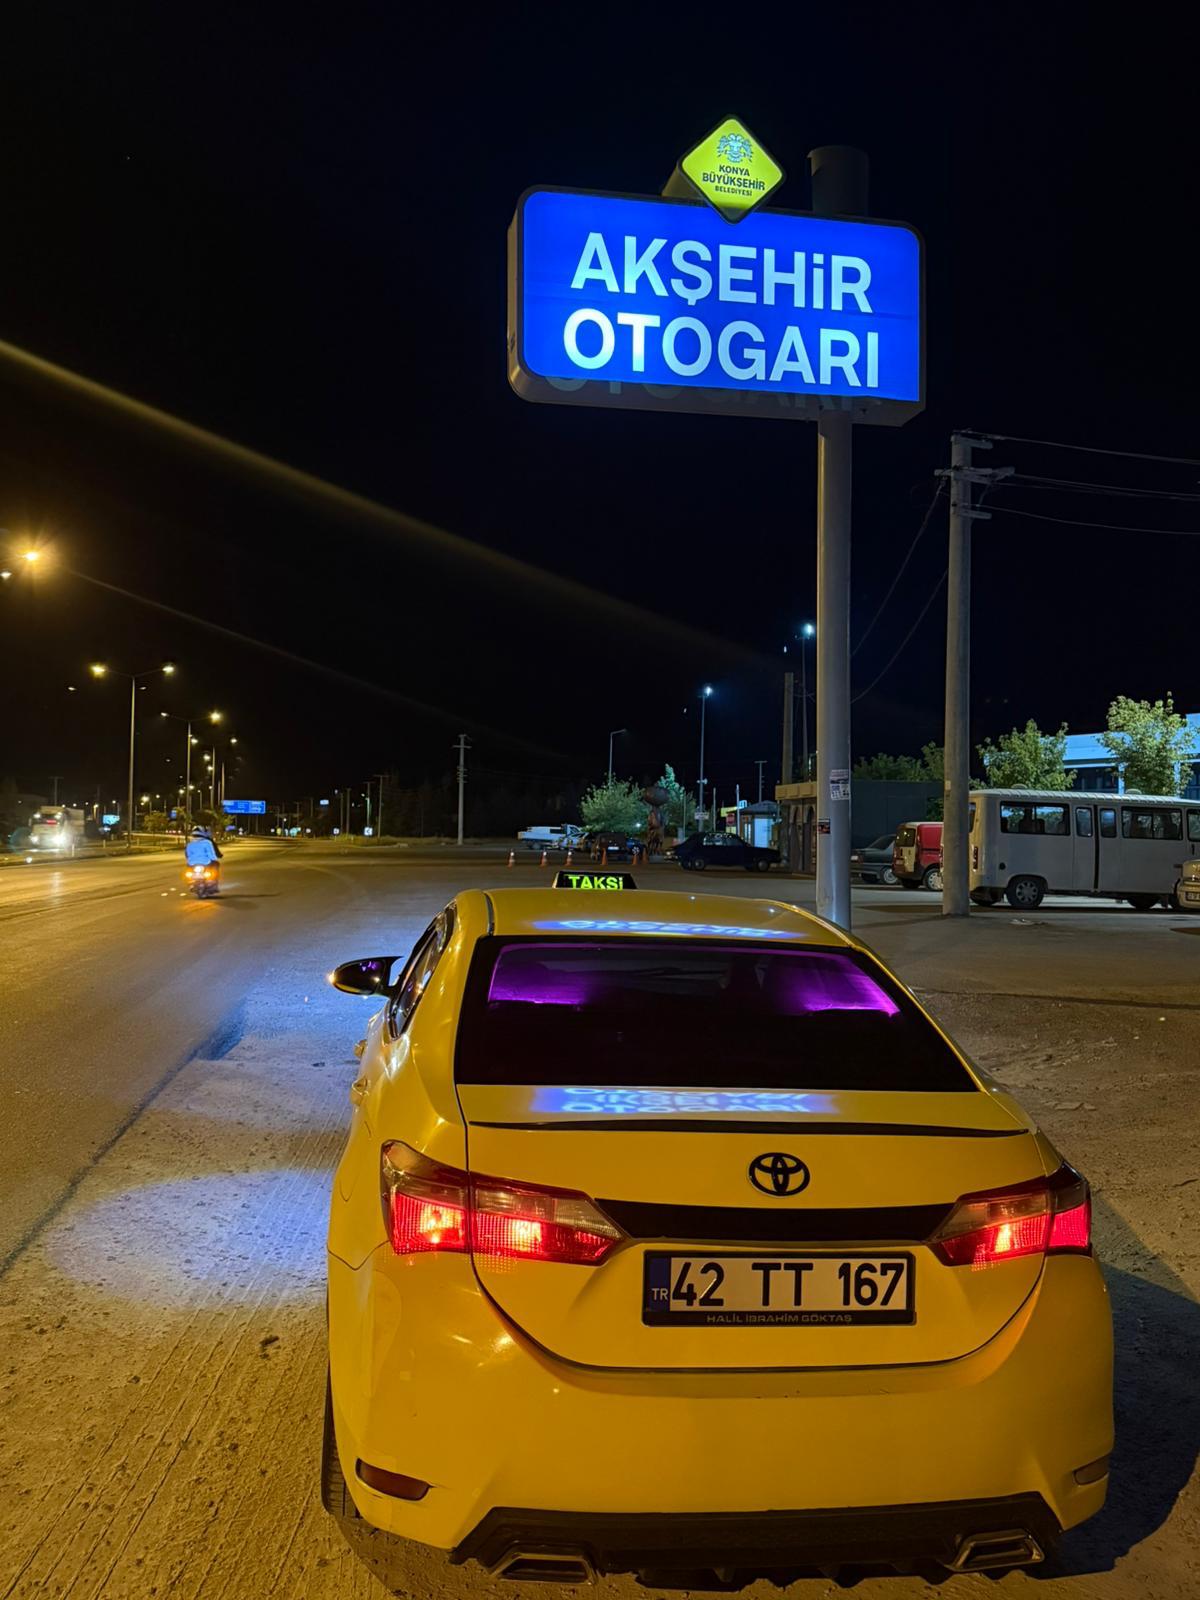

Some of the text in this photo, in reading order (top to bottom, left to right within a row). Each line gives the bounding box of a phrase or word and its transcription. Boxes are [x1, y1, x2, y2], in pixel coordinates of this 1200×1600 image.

[719, 164, 750, 177] KONYA
[570, 231, 873, 314] AKŞEHİR
[563, 307, 880, 389] OTOGARI
[651, 1287, 669, 1300] TR
[672, 1262, 905, 1307] 42 TT 167
